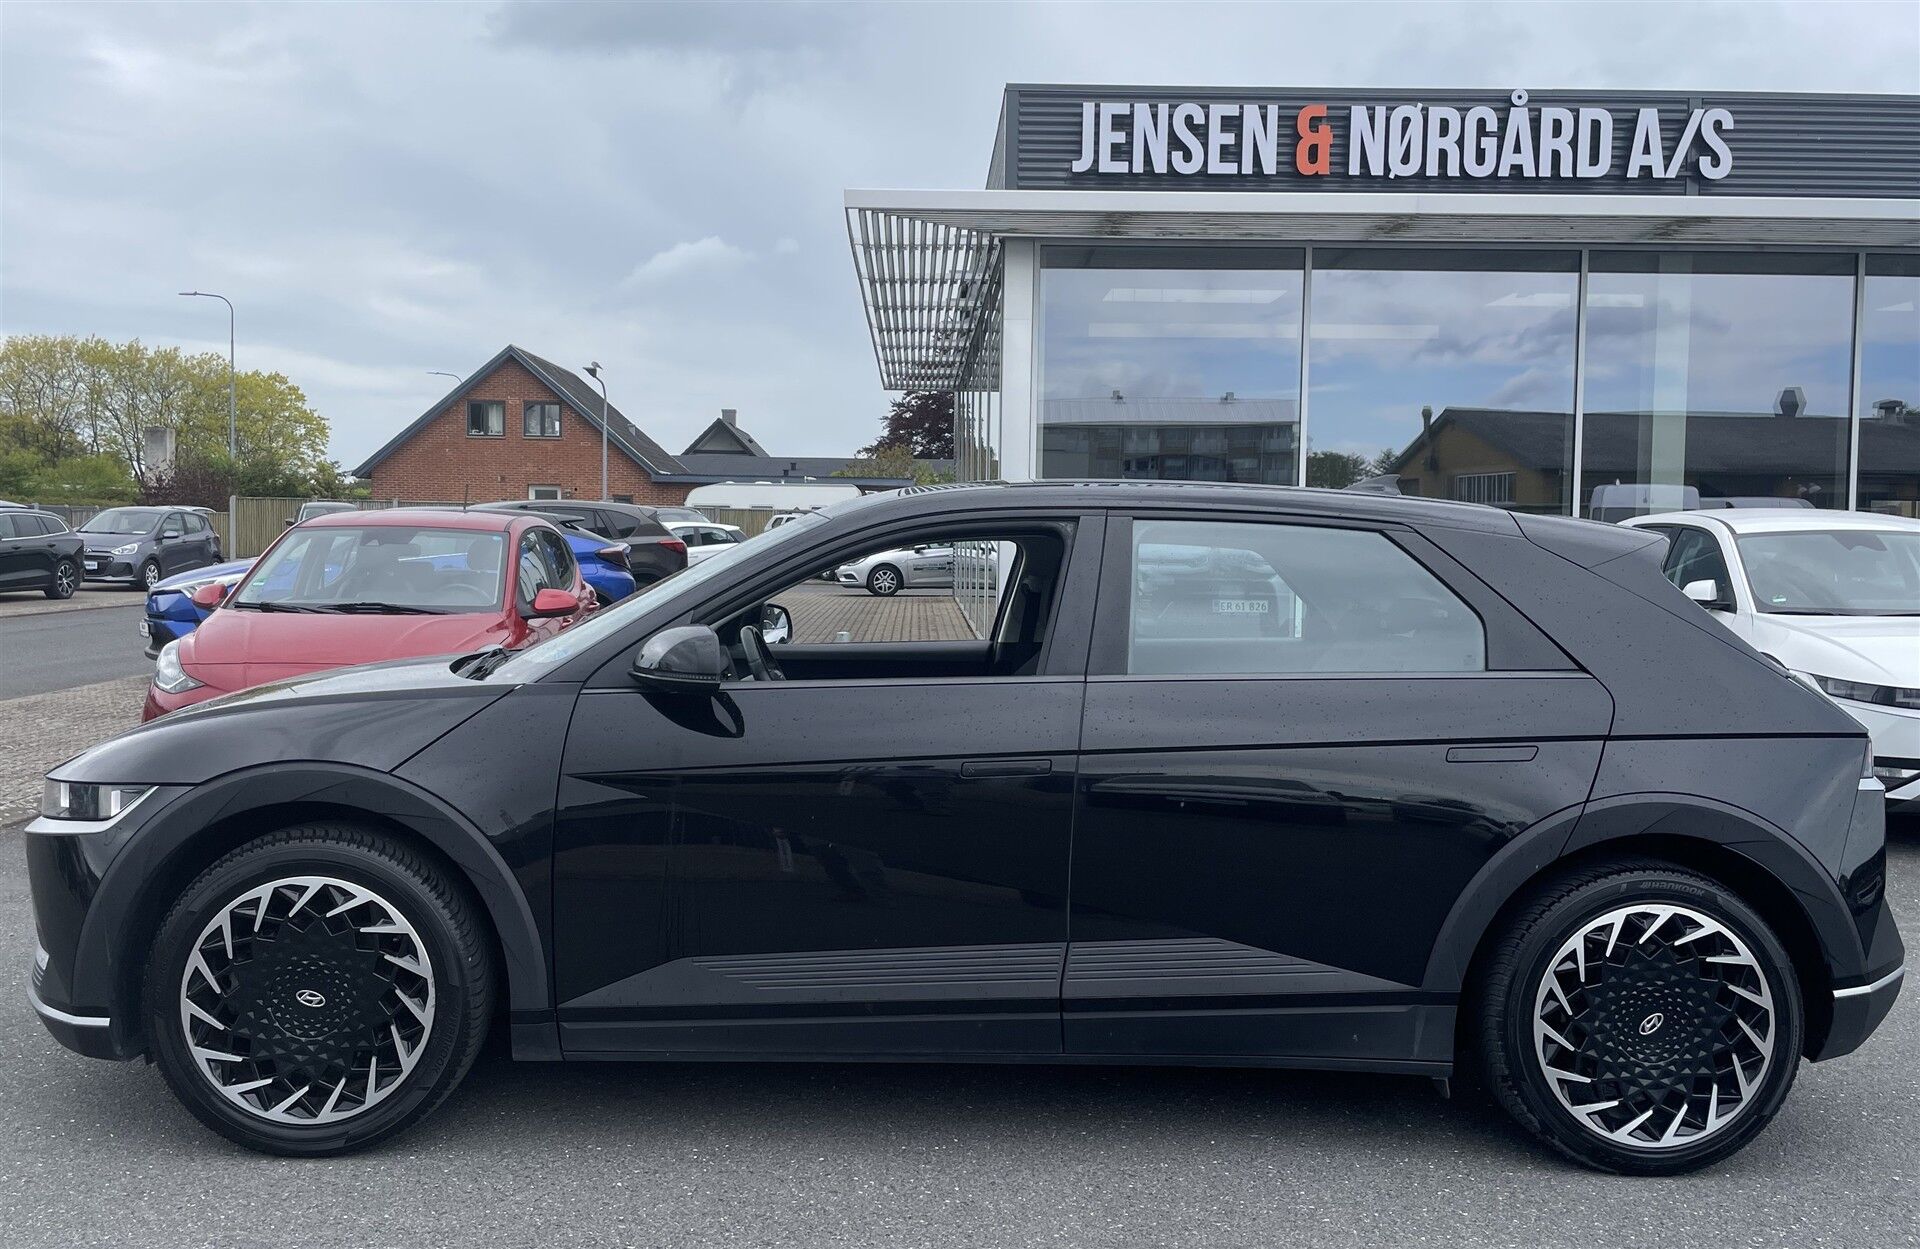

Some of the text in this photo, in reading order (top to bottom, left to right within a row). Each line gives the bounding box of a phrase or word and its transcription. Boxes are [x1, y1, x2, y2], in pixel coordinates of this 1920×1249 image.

[1072, 89, 1734, 180] JENSEN & NØRGÅRD A/S
[1220, 602, 1267, 611] ER 61 826
